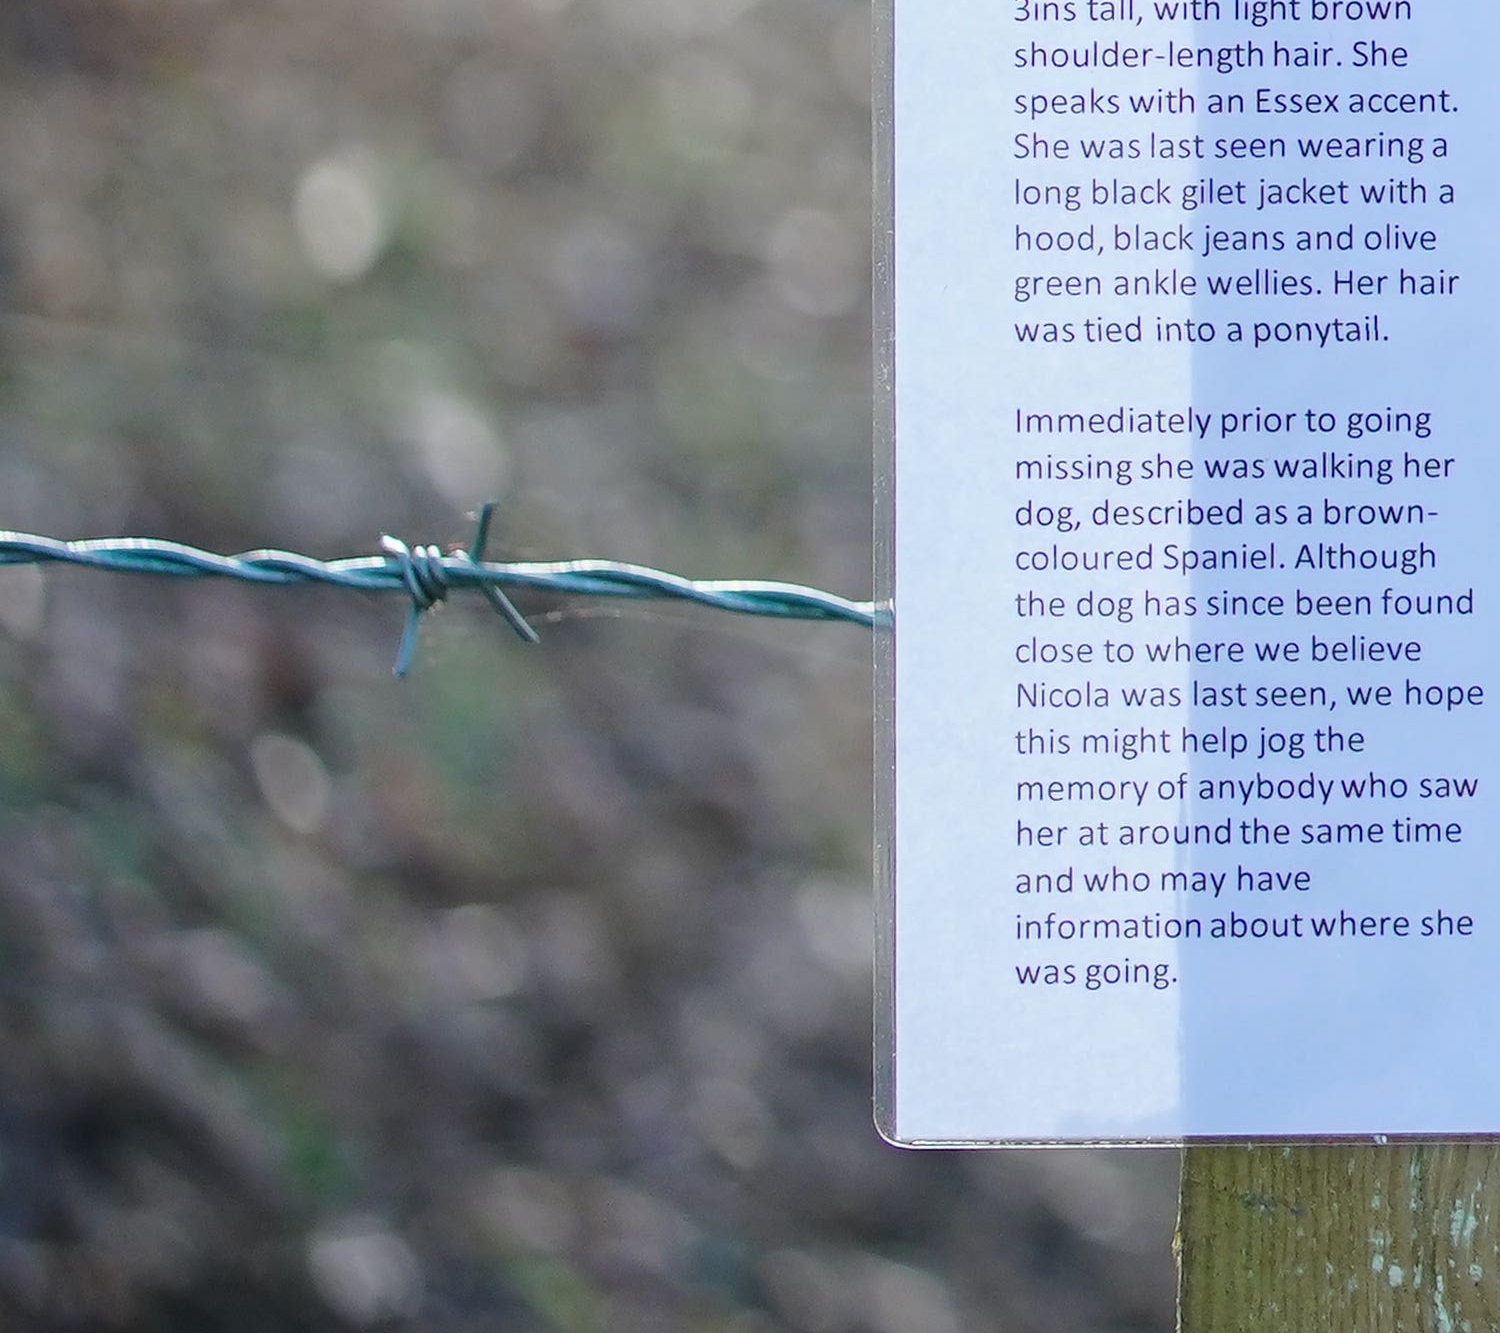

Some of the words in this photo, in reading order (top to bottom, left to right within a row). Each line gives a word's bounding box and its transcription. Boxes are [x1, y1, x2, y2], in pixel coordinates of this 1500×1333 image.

[1014, 40, 1263, 74] shoulder-length
[1274, 40, 1342, 67] hair.
[1352, 40, 1408, 67] She
[1014, 87, 1120, 120] speaks
[1129, 87, 1194, 114] with
[1208, 94, 1244, 114] an
[1256, 88, 1339, 113] Essex
[1349, 90, 1458, 113] accent.
[1016, 178, 1081, 211] long
[1092, 178, 1171, 205] black
[1181, 177, 1246, 211] gilet
[1256, 177, 1349, 211] jacket
[1360, 177, 1426, 204] with
[1439, 184, 1454, 204] a
[1016, 224, 1103, 256] hood,
[1114, 224, 1194, 251] black
[1202, 225, 1285, 257] jeans
[1296, 224, 1353, 251] and
[1364, 223, 1436, 251] olive
[1015, 276, 1101, 302] green
[1114, 268, 1197, 296] ankle
[1207, 268, 1321, 296] wellies.
[1334, 270, 1388, 295] Her
[1400, 268, 1460, 295] hair
[1017, 406, 1212, 439] Immediately
[1221, 407, 1297, 439] prior
[1304, 409, 1336, 432] to
[1347, 407, 1431, 439] going
[1016, 454, 1132, 486] missing
[1141, 453, 1194, 480] she
[1204, 459, 1265, 479] was
[1274, 452, 1393, 485] walking
[1404, 451, 1455, 478] her
[1016, 499, 1080, 533] dog,
[1092, 498, 1243, 526] described
[1255, 505, 1288, 525] as
[1297, 505, 1312, 525] a
[1324, 498, 1438, 525] brown-
[1016, 543, 1152, 571] coloured
[1163, 542, 1285, 576] Spaniel.
[1294, 542, 1435, 575] Although
[1017, 681, 1109, 708] Nicola
[1121, 687, 1181, 707] was
[1193, 680, 1247, 707] last
[1256, 687, 1336, 711] seen,
[1347, 686, 1392, 706] we
[1406, 678, 1484, 712] hope
[1017, 781, 1149, 807] memory
[1158, 772, 1188, 800] of
[1199, 771, 1334, 806] anybody
[1341, 771, 1408, 799] who
[1419, 778, 1478, 798] saw
[1016, 866, 1073, 894] and
[1083, 865, 1150, 892] who
[1161, 872, 1226, 898] may
[1238, 865, 1310, 892] have
[1017, 912, 1201, 940] information
[1210, 911, 1303, 938] about
[1310, 910, 1410, 937] where
[1421, 909, 1473, 937] she
[1015, 965, 1076, 985] was
[1085, 958, 1177, 990] going.
